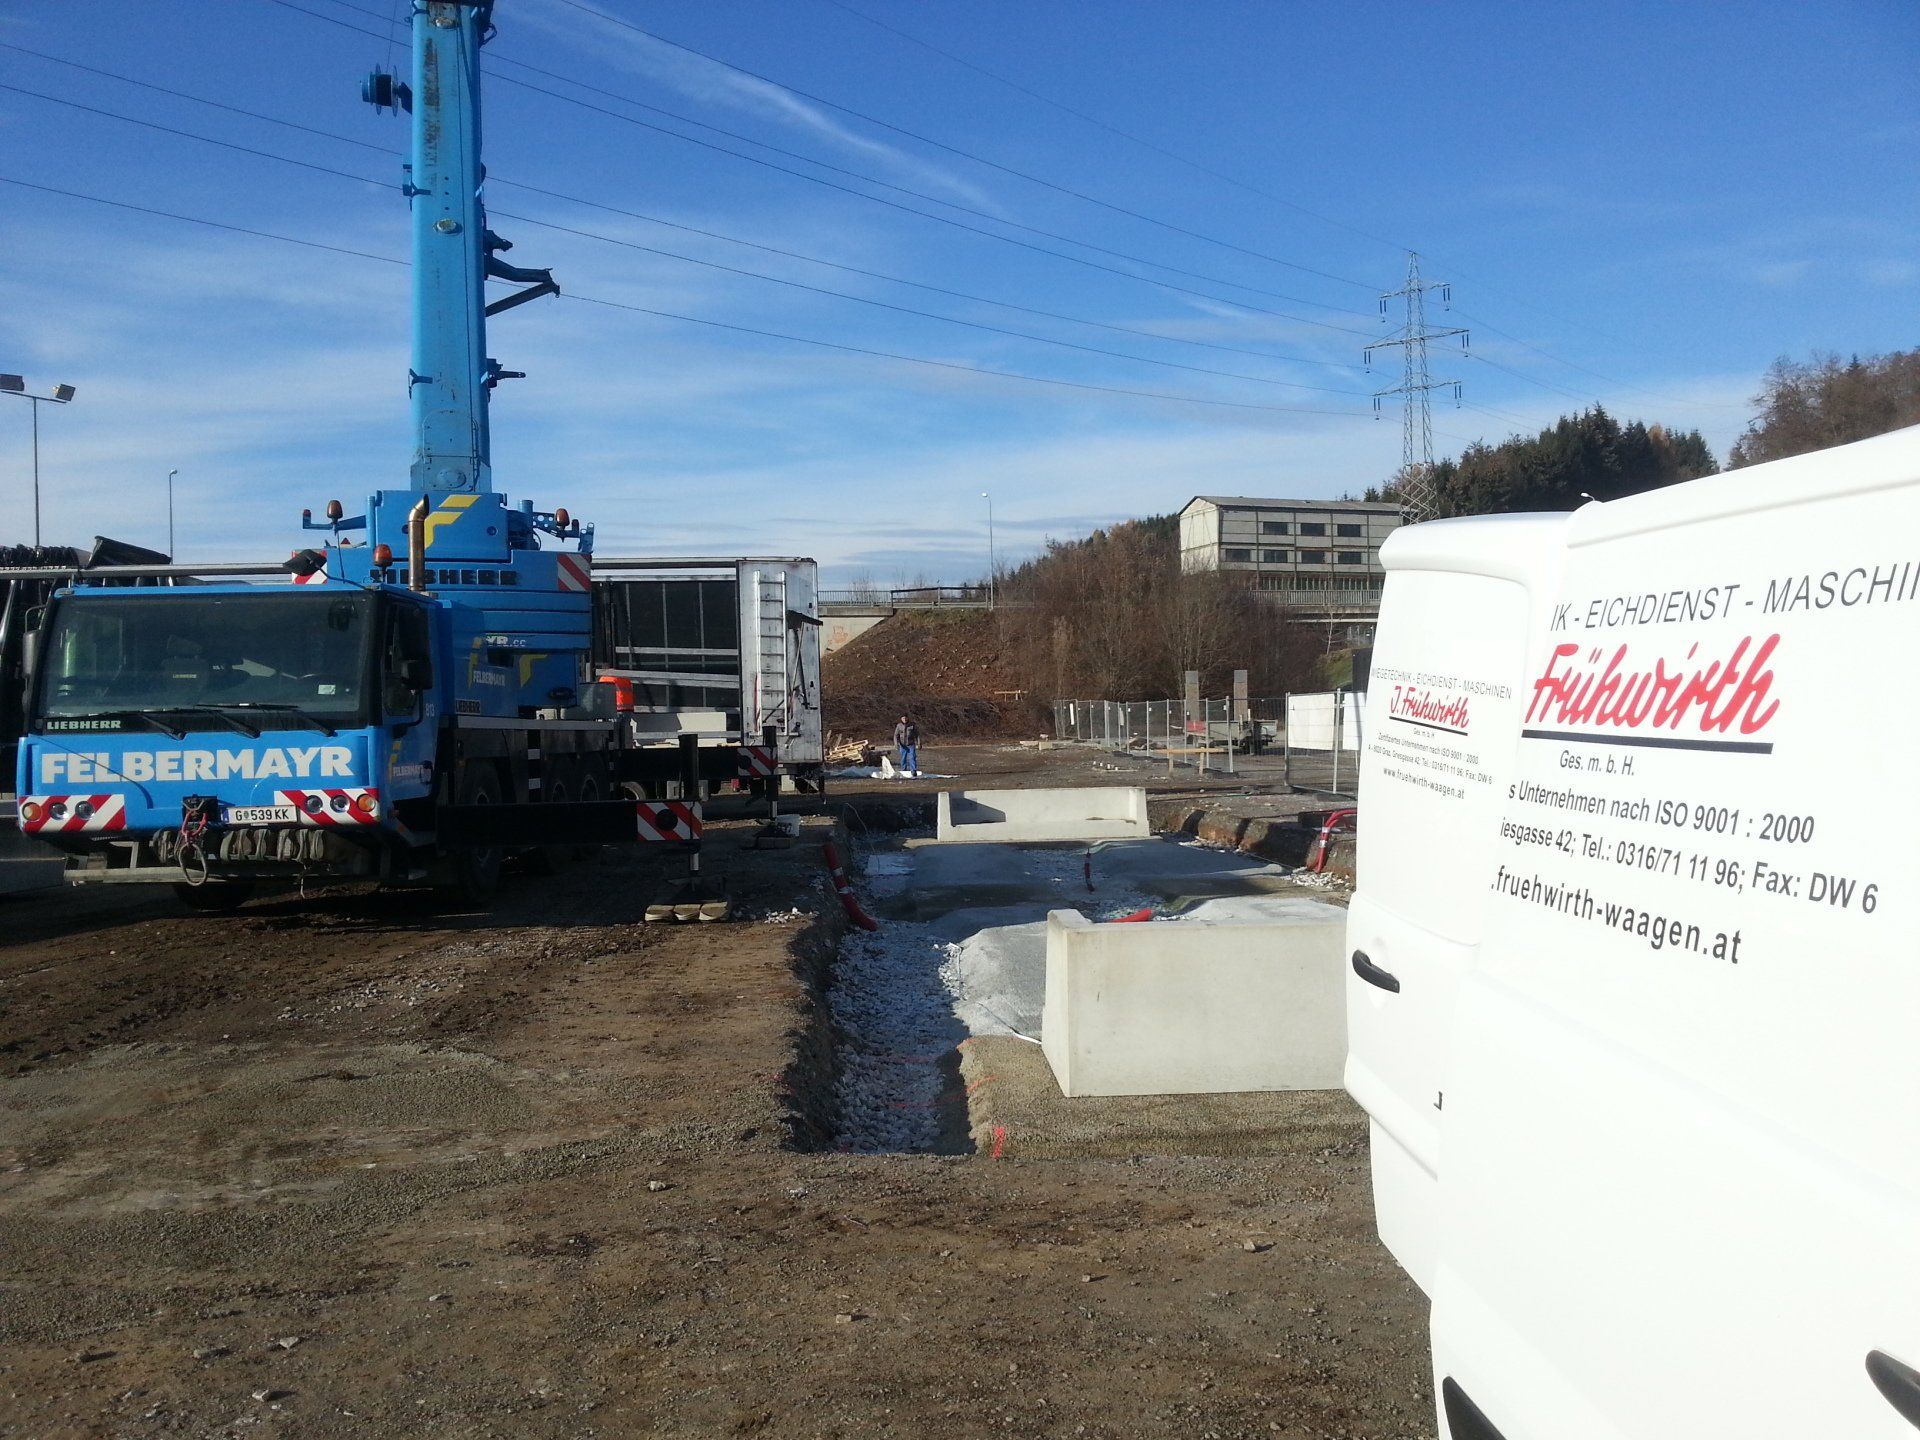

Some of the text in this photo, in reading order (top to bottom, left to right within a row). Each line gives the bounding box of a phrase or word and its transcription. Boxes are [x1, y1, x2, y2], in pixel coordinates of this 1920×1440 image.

[1550, 603, 1572, 631] IK
[1585, 584, 1740, 629] EICHDIENST
[473, 670, 506, 687] FELBERMAYR
[1463, 680, 1512, 699] MASCHINEN
[1525, 633, 1781, 735] Frühwirth
[46, 720, 122, 730] LIEBHERR
[41, 746, 354, 784] FELBERMAYR
[1560, 750, 1584, 770] Ges.
[1519, 780, 1606, 815] Unternehmen
[1610, 798, 1651, 822] nach
[1655, 800, 1688, 827] ISO
[1693, 805, 1739, 835] 9001
[1759, 813, 1815, 843] 2000
[1500, 816, 1878, 914] iesgasse 42; Tel.: 0316/71 11 96; Fax: DW 6
[1491, 865, 1742, 965] .fruehwirth-waagen.at
